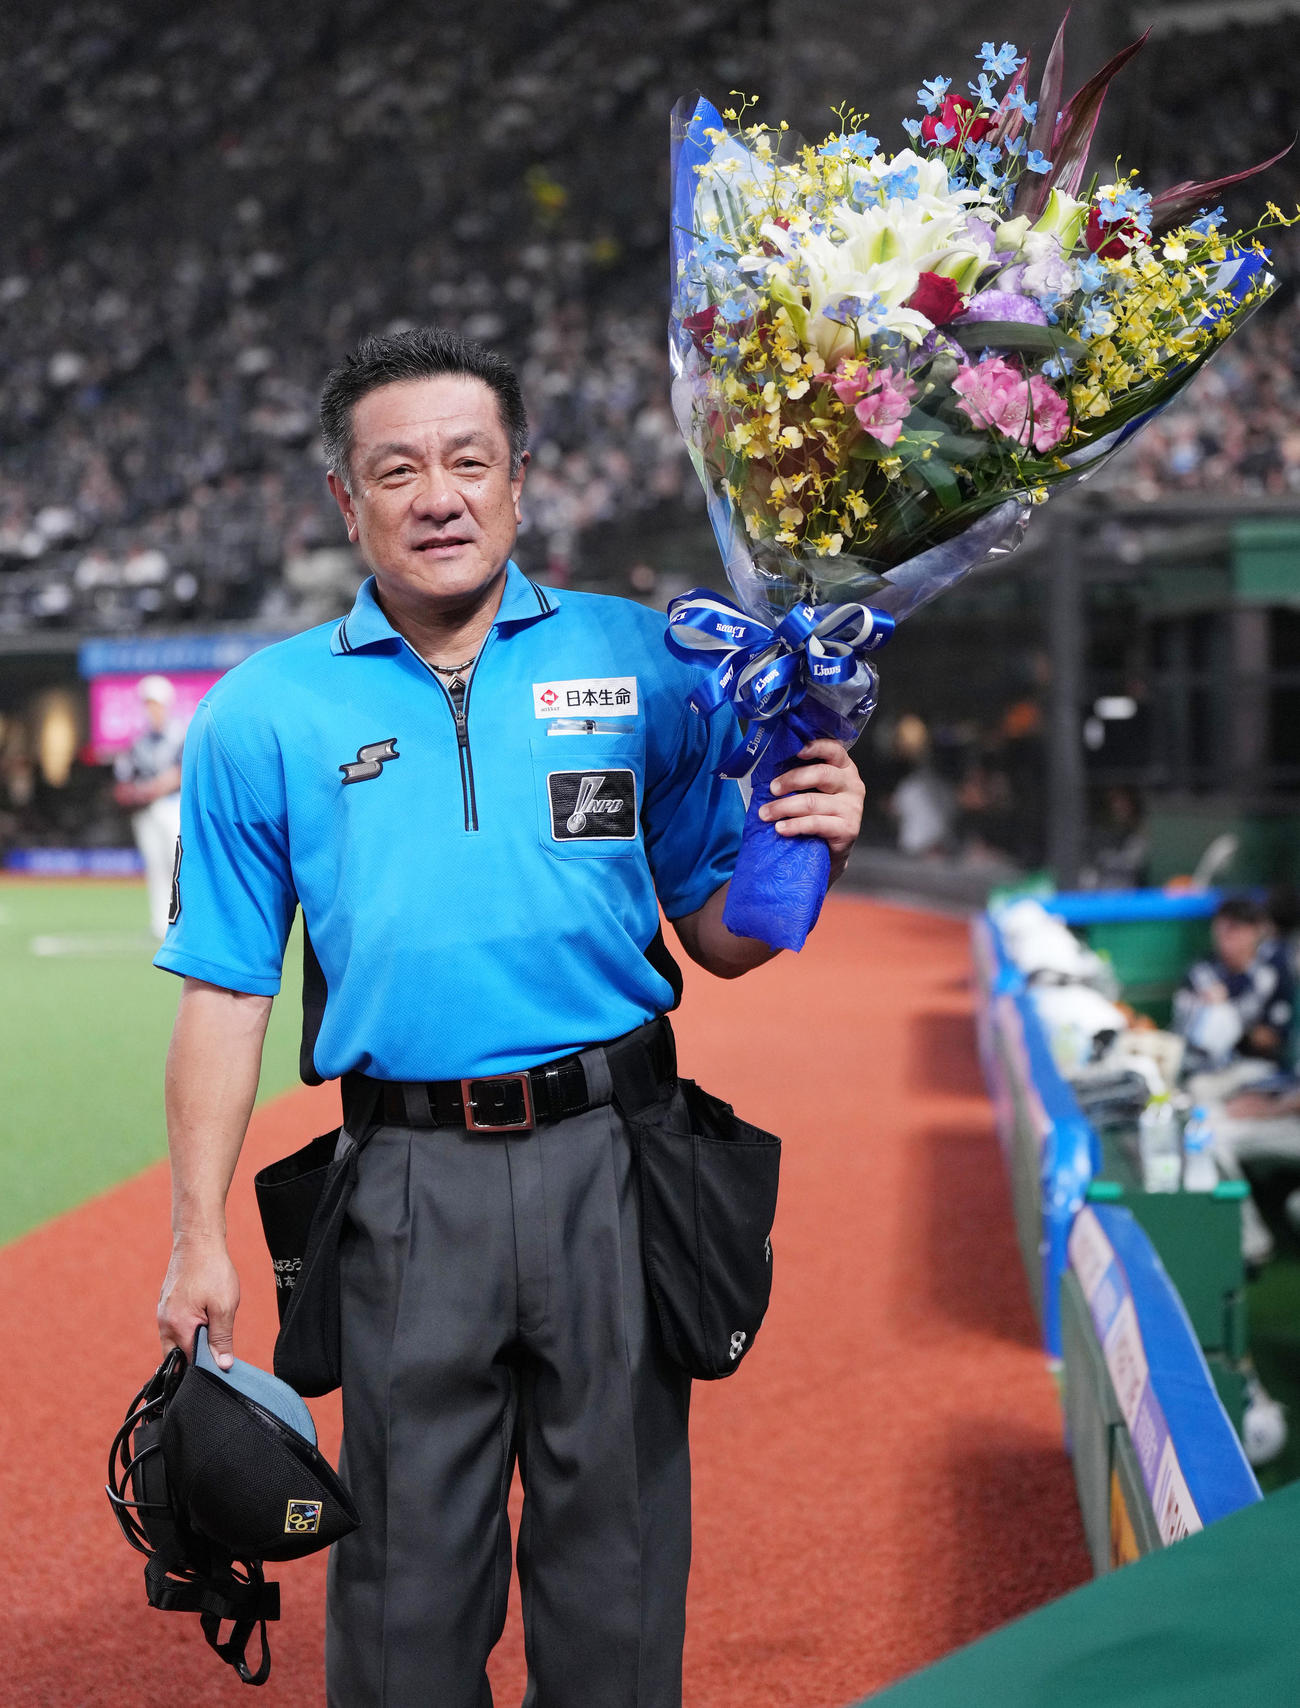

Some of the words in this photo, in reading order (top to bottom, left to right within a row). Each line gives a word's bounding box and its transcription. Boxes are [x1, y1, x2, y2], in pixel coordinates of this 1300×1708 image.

[716, 622, 747, 639] Lions
[813, 664, 841, 676] Lions
[754, 668, 780, 694] Lions
[566, 688, 631, 707] 日本生命
[746, 726, 765, 756] Lions
[583, 798, 624, 814] NPB
